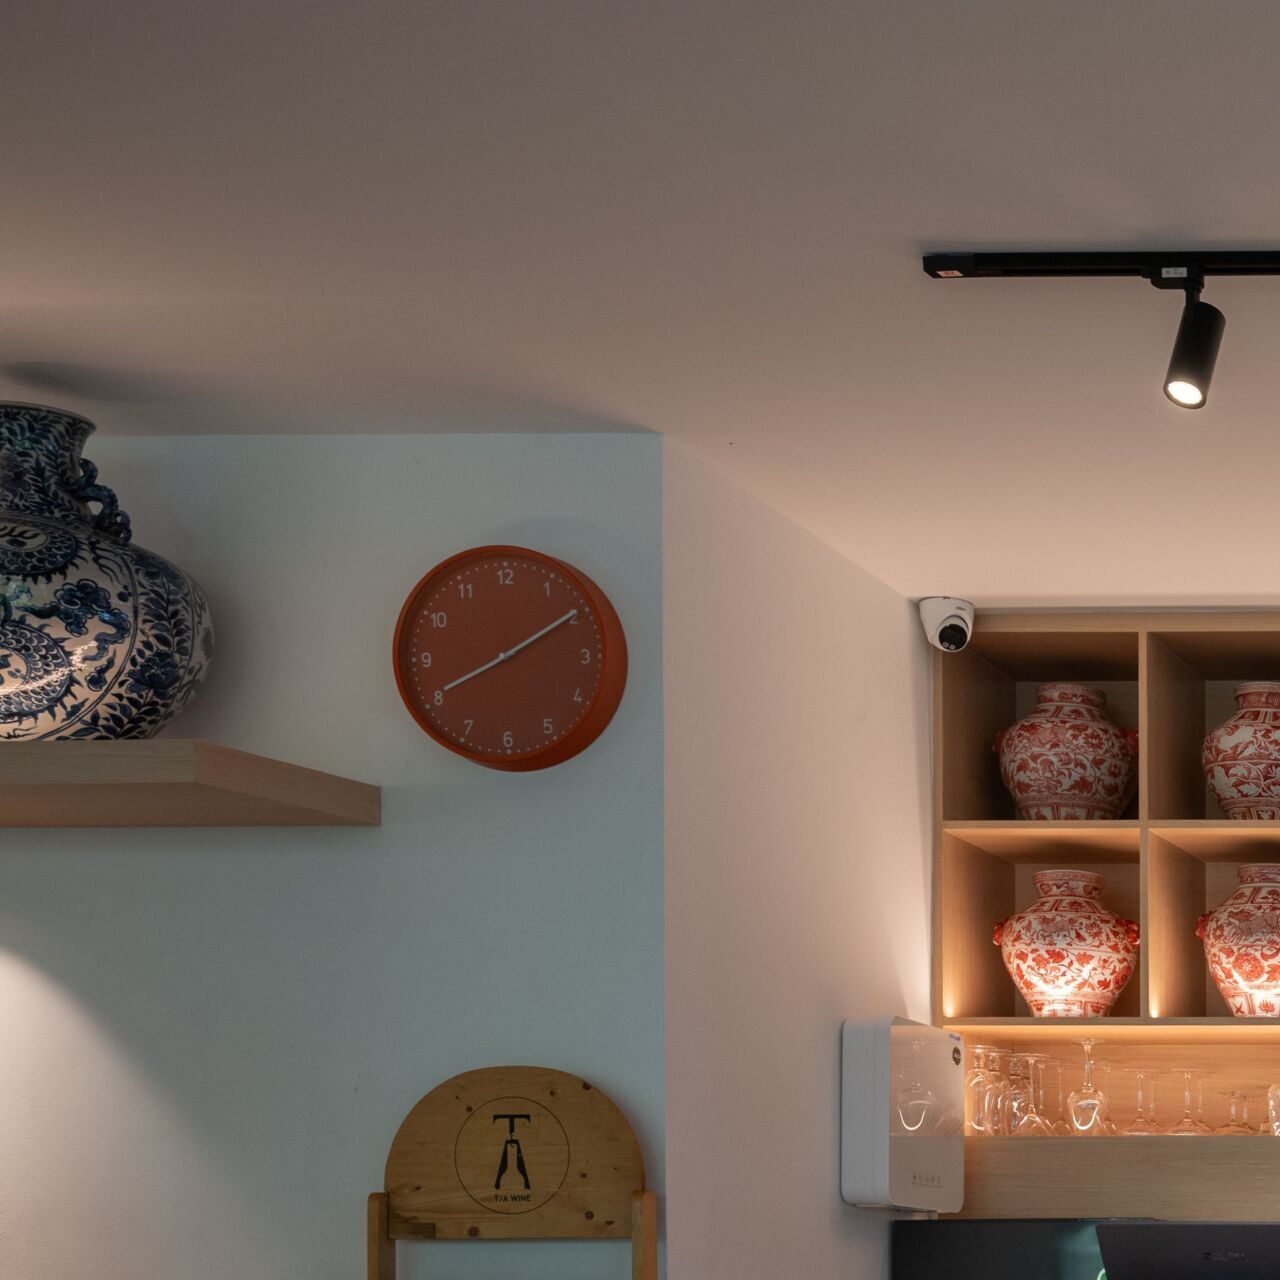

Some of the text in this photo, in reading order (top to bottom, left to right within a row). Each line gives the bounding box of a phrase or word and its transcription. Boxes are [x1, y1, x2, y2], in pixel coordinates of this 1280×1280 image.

[497, 569, 514, 585] 12
[458, 584, 473, 599] 11
[543, 583, 551, 597] 1
[430, 612, 447, 628] 10
[568, 609, 578, 625] 2
[421, 652, 432, 668] 9
[580, 648, 591, 665] 3
[434, 690, 444, 706] 8
[573, 687, 582, 704] 4
[464, 720, 473, 735] 7
[543, 718, 553, 734] 5
[503, 731, 513, 748] 6
[511, 1194, 532, 1202] WINE
